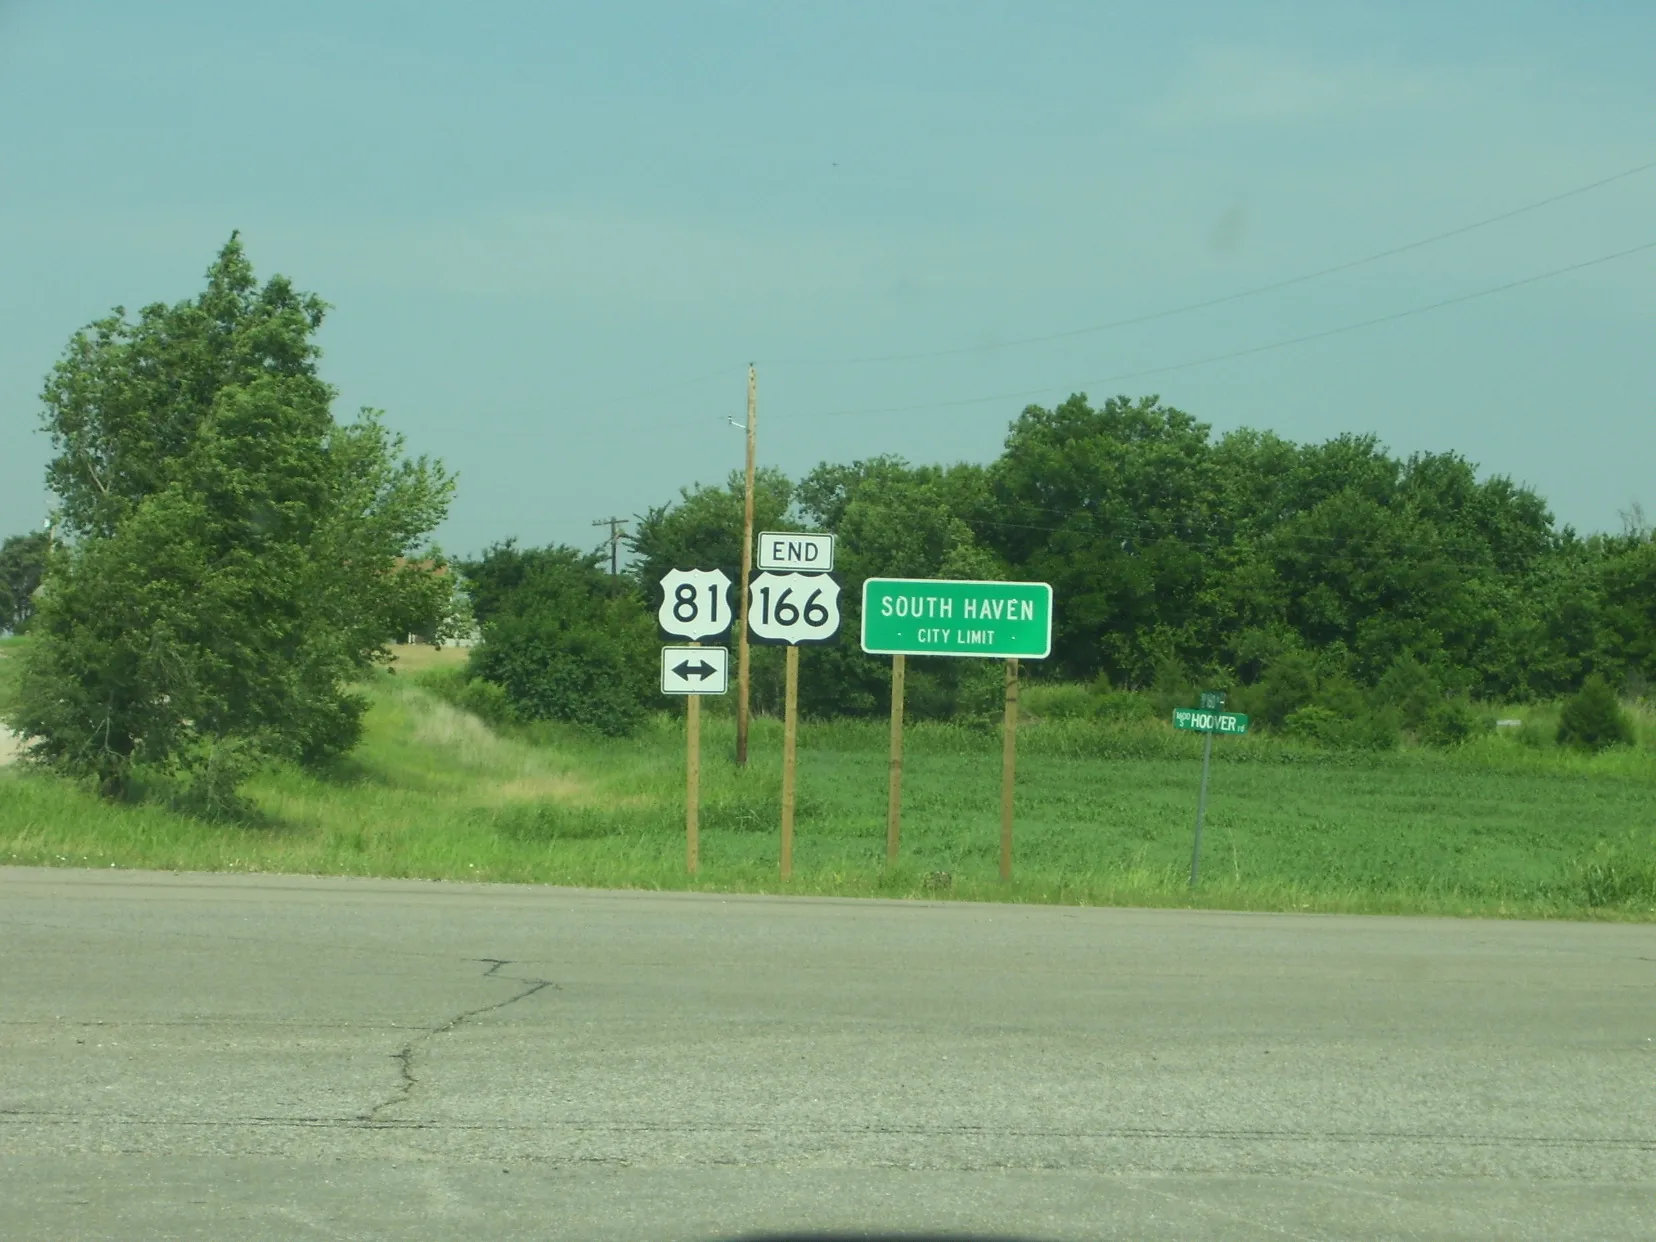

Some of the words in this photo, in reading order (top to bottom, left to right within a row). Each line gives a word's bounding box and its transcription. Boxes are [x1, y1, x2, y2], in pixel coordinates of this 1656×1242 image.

[773, 541, 818, 562] END
[673, 583, 717, 622] 81
[760, 587, 829, 627] 166
[881, 596, 952, 618] SOUTH
[964, 599, 1033, 620] HAVEN
[918, 628, 951, 643] CITY
[957, 630, 995, 645] LIMIT
[1191, 713, 1236, 731] HOOVER
